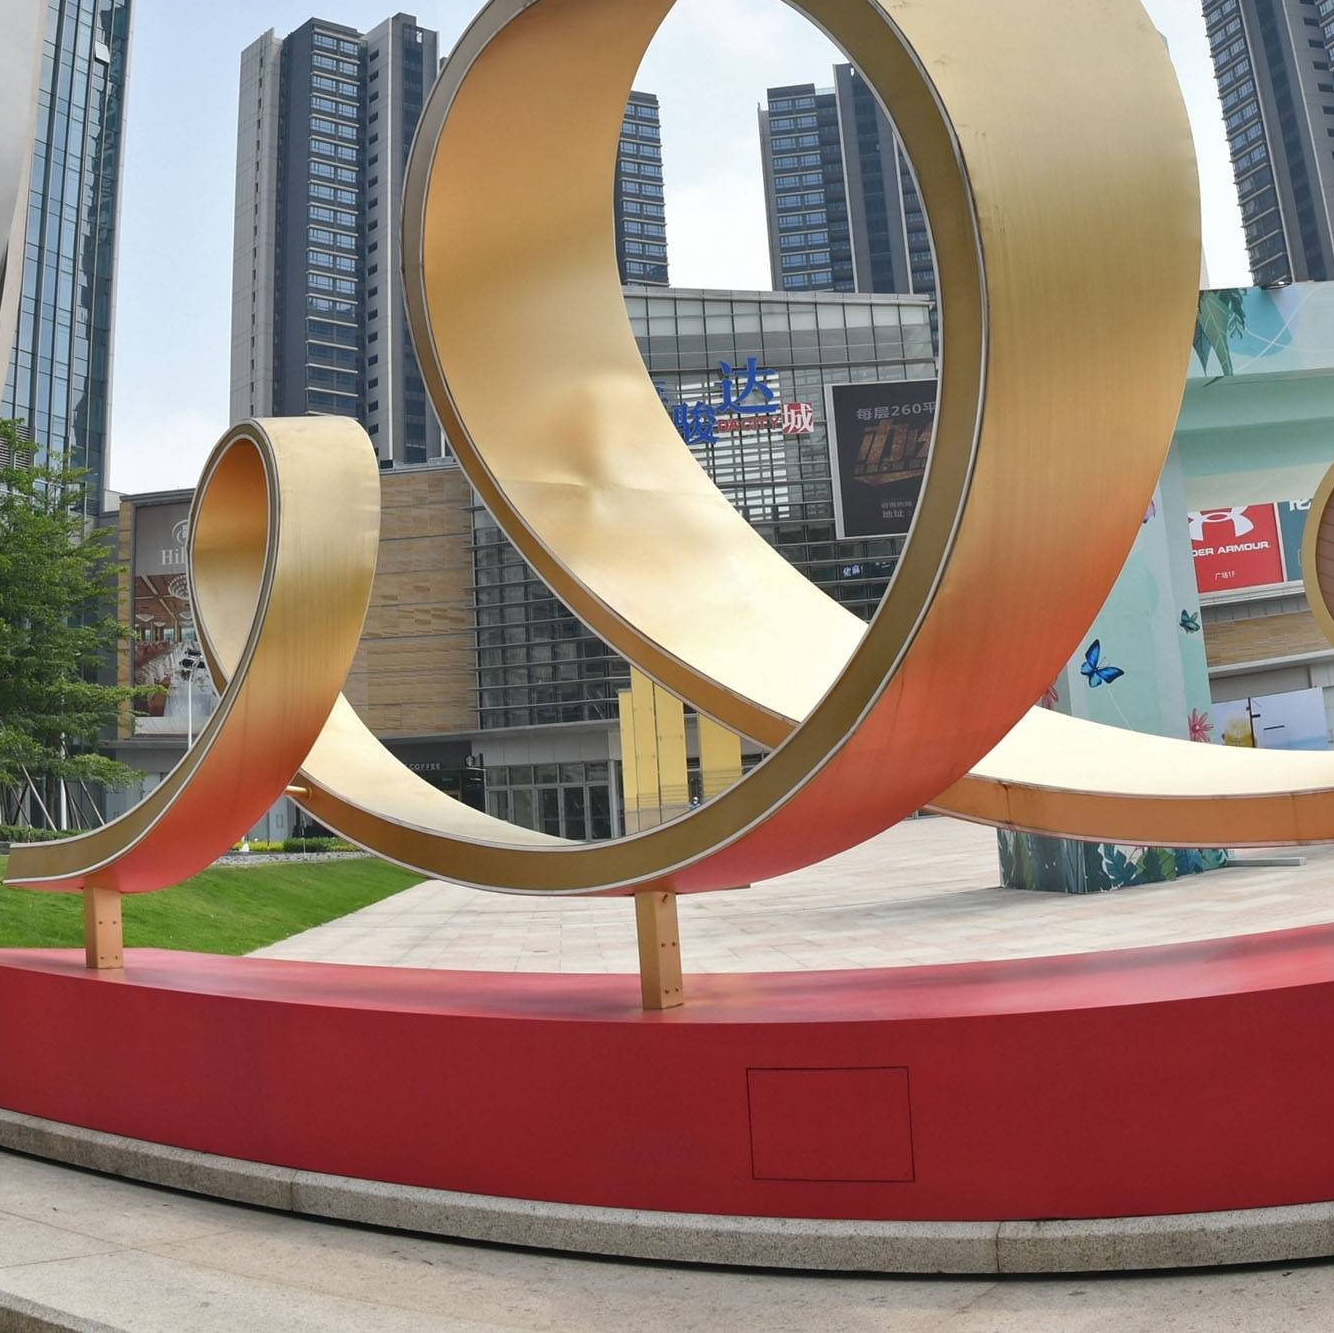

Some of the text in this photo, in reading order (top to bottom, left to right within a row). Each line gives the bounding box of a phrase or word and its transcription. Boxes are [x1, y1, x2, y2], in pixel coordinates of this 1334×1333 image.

[655, 356, 814, 444] 骏达城
[717, 416, 780, 432] DA CITY
[1218, 541, 1269, 554] ARMOUR
